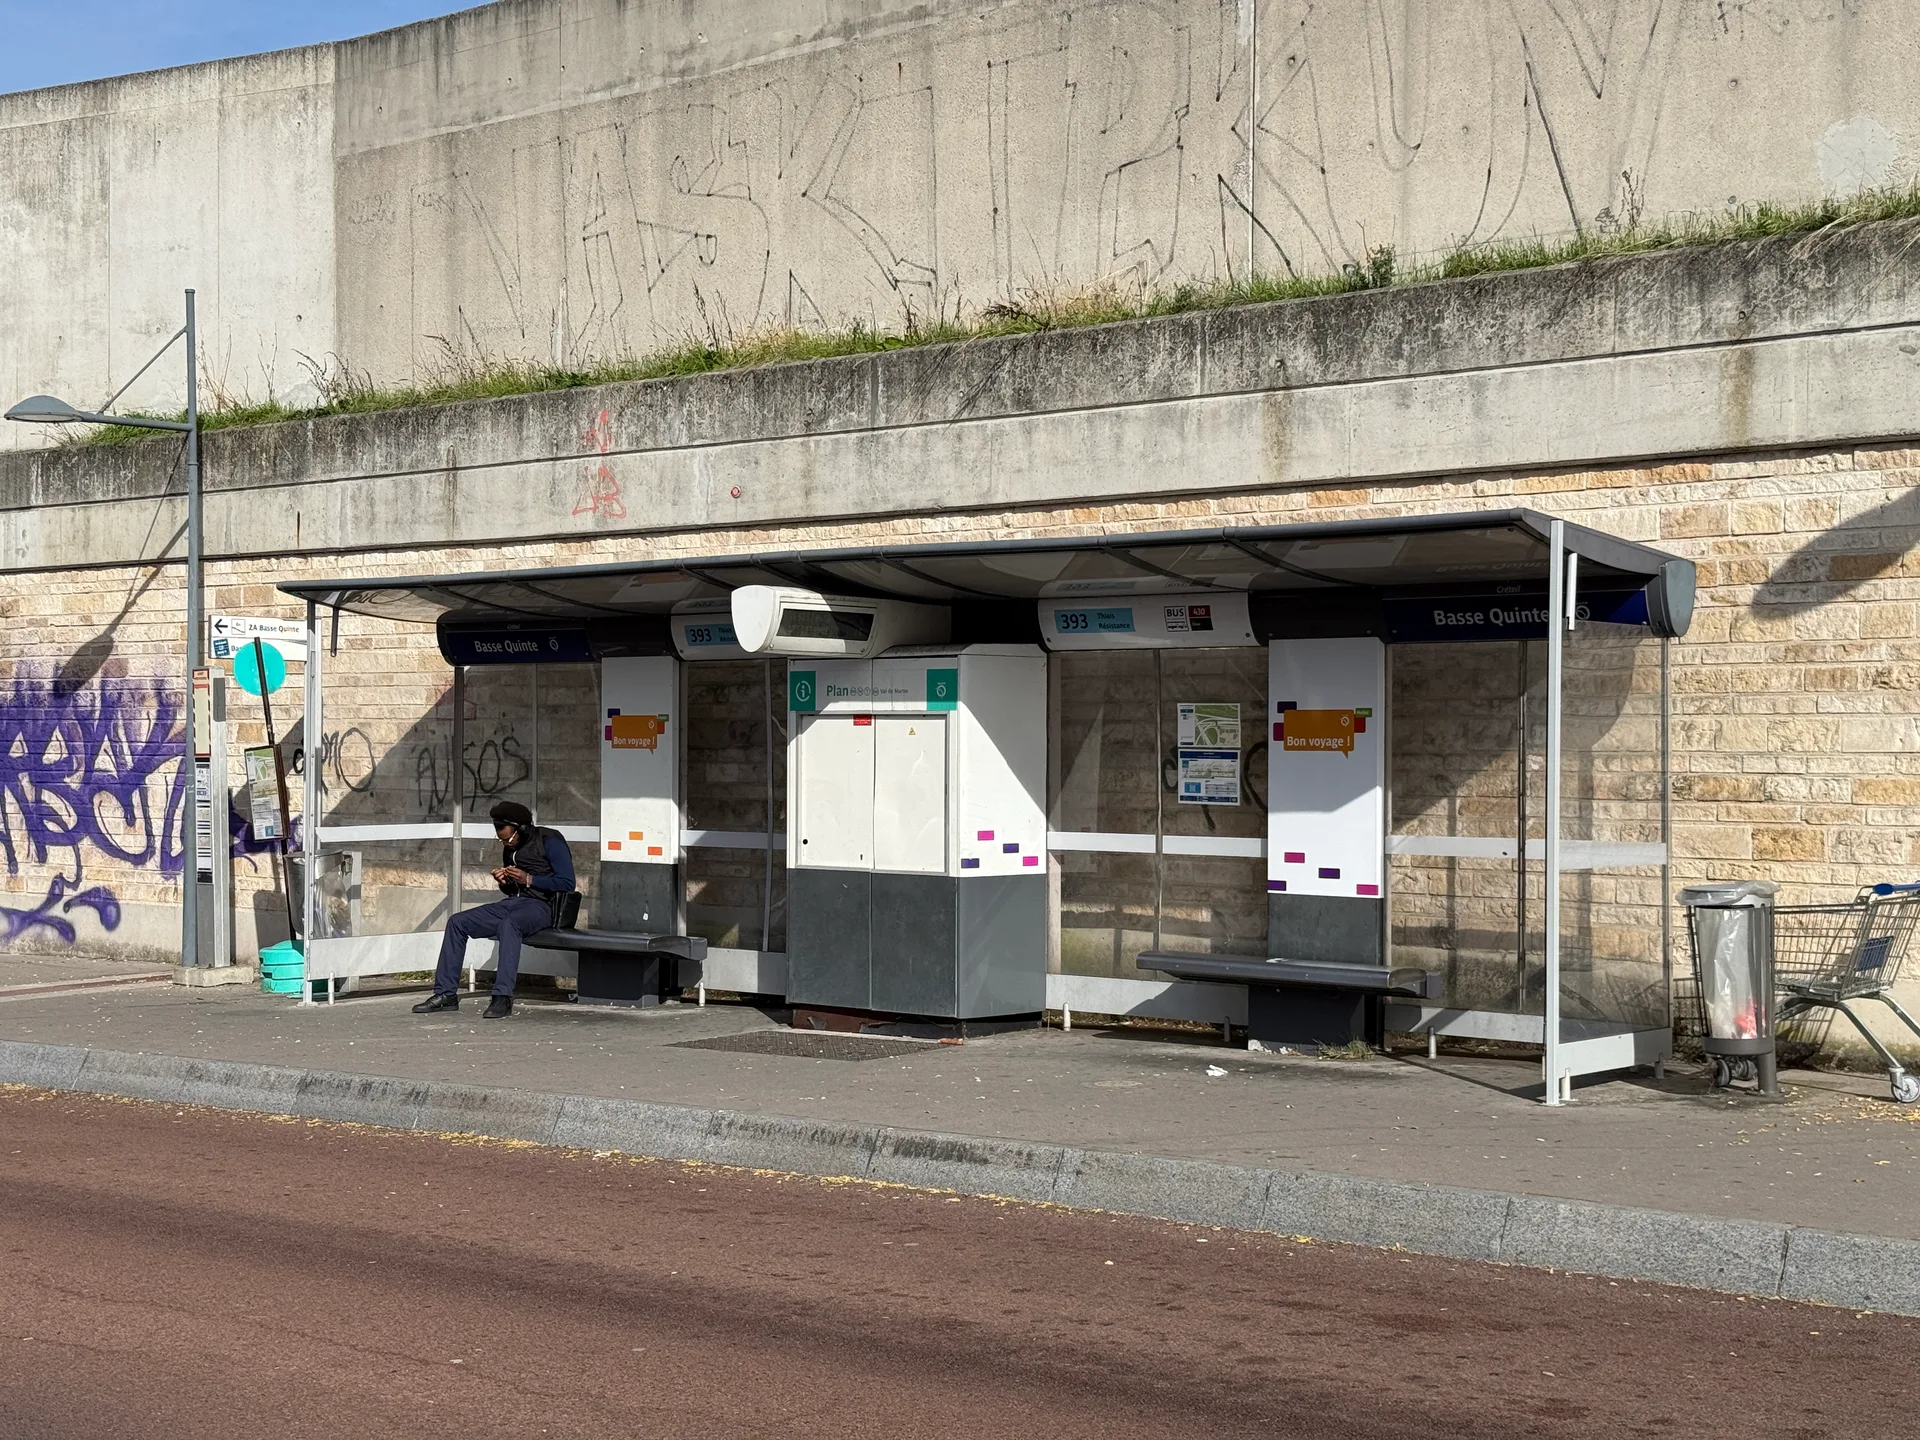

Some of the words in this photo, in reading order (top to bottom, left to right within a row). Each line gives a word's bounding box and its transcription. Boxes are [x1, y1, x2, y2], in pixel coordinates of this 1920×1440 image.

[1496, 584, 1521, 594] Créteil
[1166, 608, 1185, 618] BUS
[1192, 608, 1205, 616] 430
[1433, 610, 1485, 626] Basse
[1489, 607, 1549, 627] Quinte
[1060, 613, 1089, 630] 393
[1096, 612, 1115, 620] Thiais
[1098, 621, 1131, 630] Résistance
[259, 623, 277, 632] Basse
[689, 628, 712, 643] 393
[474, 640, 503, 653] Basse
[504, 640, 539, 653] Quinte
[826, 685, 849, 697] Plan
[613, 736, 627, 745] Bon
[627, 738, 651, 747] voyage
[1287, 736, 1306, 747] Bon
[1308, 738, 1344, 749] voyage
[1346, 736, 1351, 747] !
